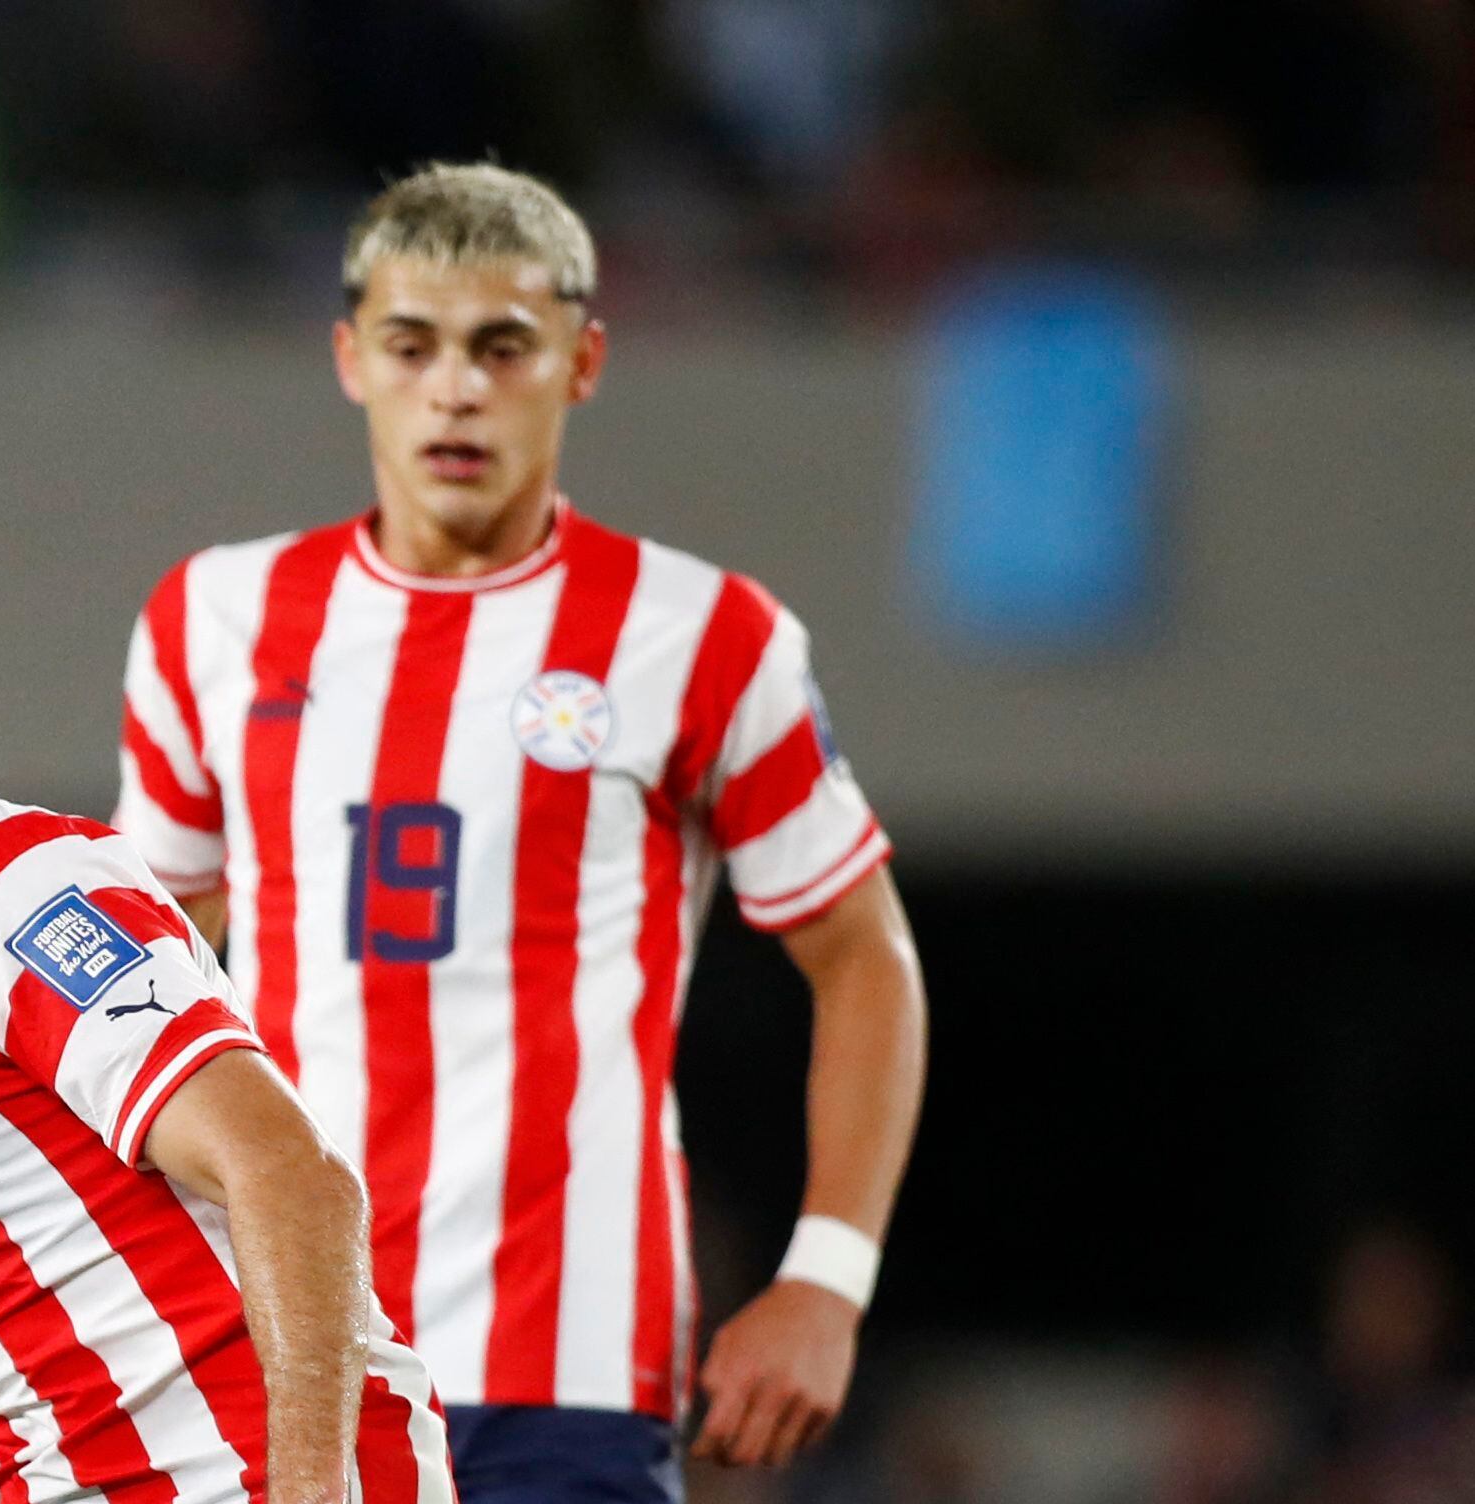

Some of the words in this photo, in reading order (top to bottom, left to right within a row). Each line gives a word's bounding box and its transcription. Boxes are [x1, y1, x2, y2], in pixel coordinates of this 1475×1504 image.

[346, 803, 462, 961] 19
[32, 907, 82, 950] FOOTBALL
[44, 917, 96, 962] UNITES
[59, 956, 81, 977] the
[74, 928, 113, 959] World
[89, 953, 110, 972] FIFA
